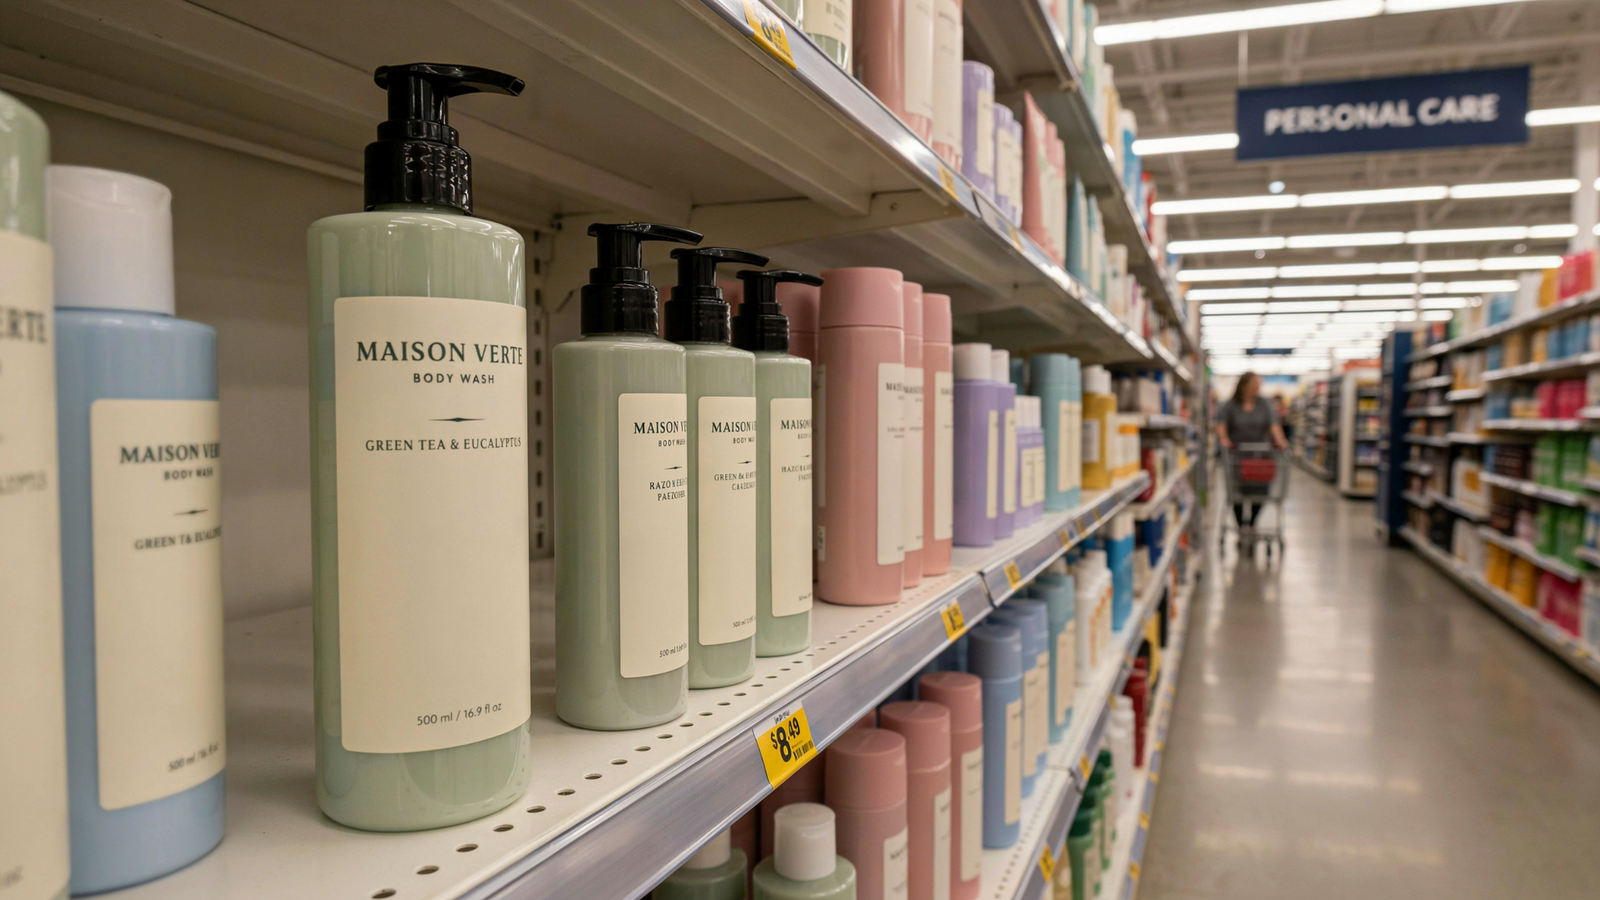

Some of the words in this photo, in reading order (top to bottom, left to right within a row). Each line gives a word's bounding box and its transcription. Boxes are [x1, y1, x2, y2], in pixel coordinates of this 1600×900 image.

[1265, 101, 1415, 134] PERSONAL
[1418, 94, 1500, 125] CARE
[357, 341, 466, 362] MAISON
[474, 344, 523, 365] VERTE
[413, 373, 453, 383] BODY
[461, 374, 495, 384] WASH
[634, 421, 679, 434] MAISON
[711, 421, 751, 433] MAISON
[366, 440, 413, 451] GREEN
[419, 440, 446, 450] TEA
[451, 439, 459, 450] &
[464, 437, 521, 450] EUCALYPTUS
[120, 445, 199, 464] MAISON
[164, 470, 193, 481] BODY
[135, 536, 176, 551] GREEN
[659, 650, 669, 658] 500
[417, 715, 437, 726] 500
[441, 711, 453, 723] ml
[456, 710, 461, 722] /
[464, 706, 482, 719] 16.9
[485, 703, 490, 714] fl
[493, 703, 502, 712] oz
